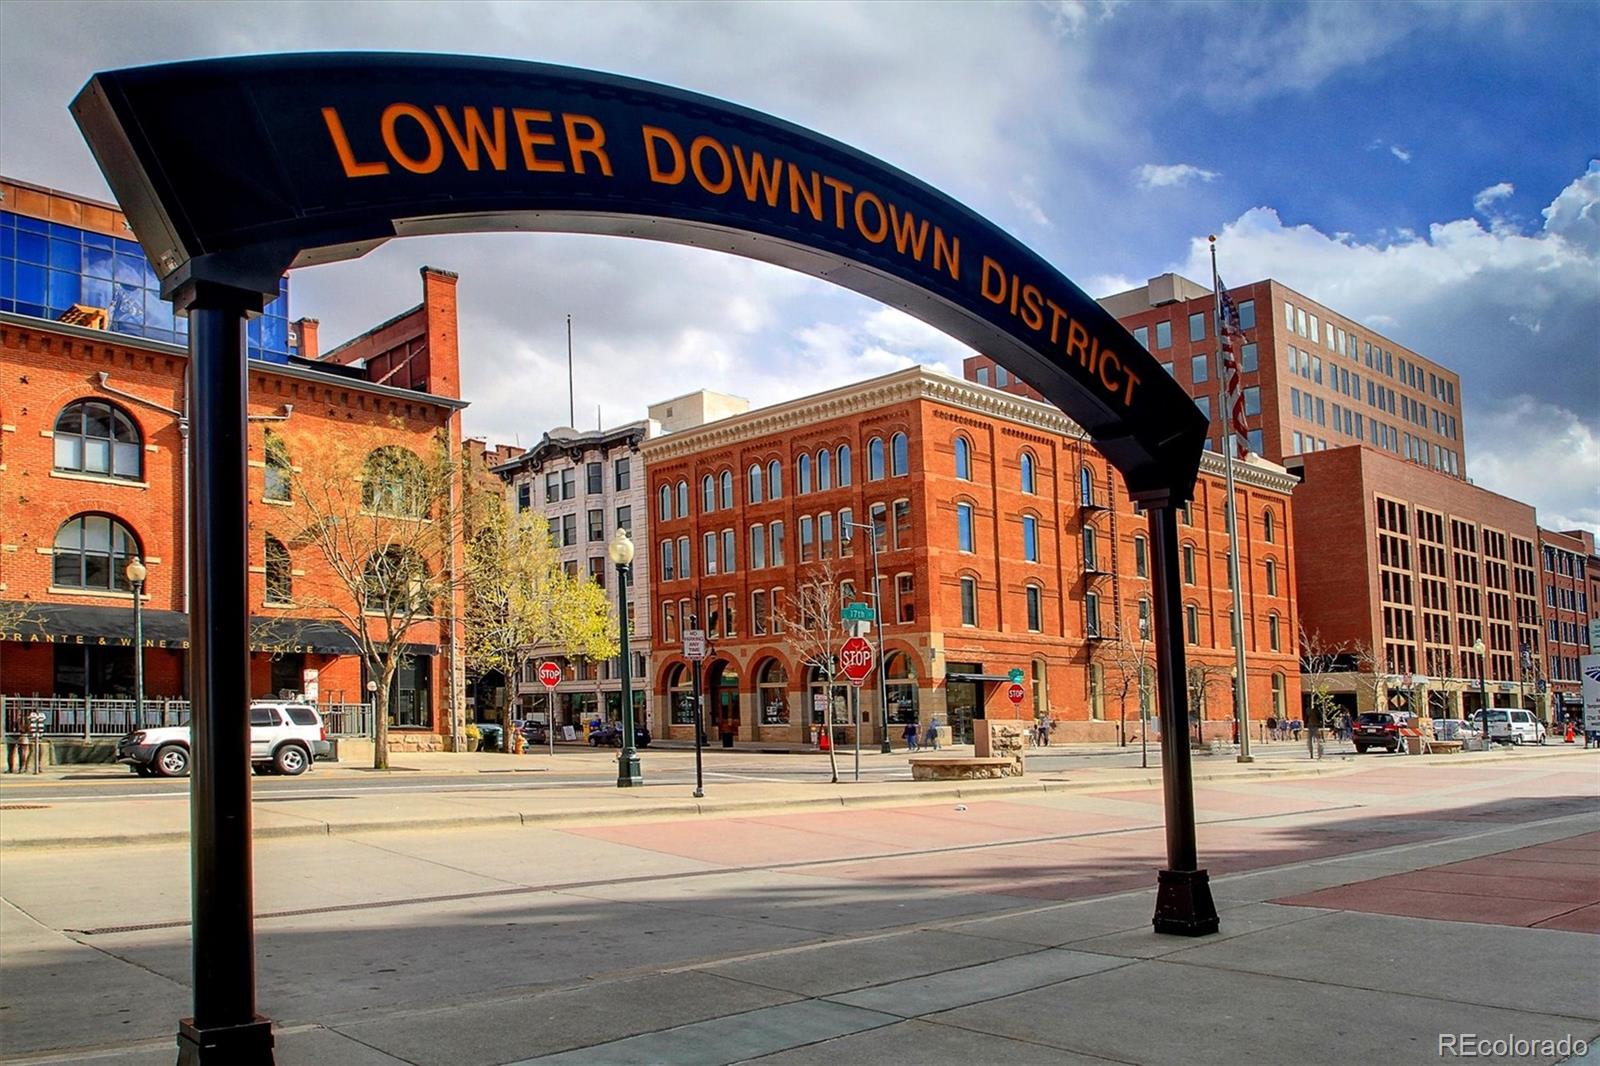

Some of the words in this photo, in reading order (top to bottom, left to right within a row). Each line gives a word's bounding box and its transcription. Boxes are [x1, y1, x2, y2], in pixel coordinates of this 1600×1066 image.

[321, 102, 614, 178] LOWER
[641, 124, 960, 281] DOWNTOWN
[981, 255, 1141, 406] DISTRICT
[849, 609, 865, 618] 17th
[98, 637, 106, 645] &
[121, 638, 167, 648] WNE
[249, 644, 313, 654] VENICE
[843, 650, 870, 666] STOP
[541, 669, 560, 679] STOP
[1009, 689, 1023, 698] STOP
